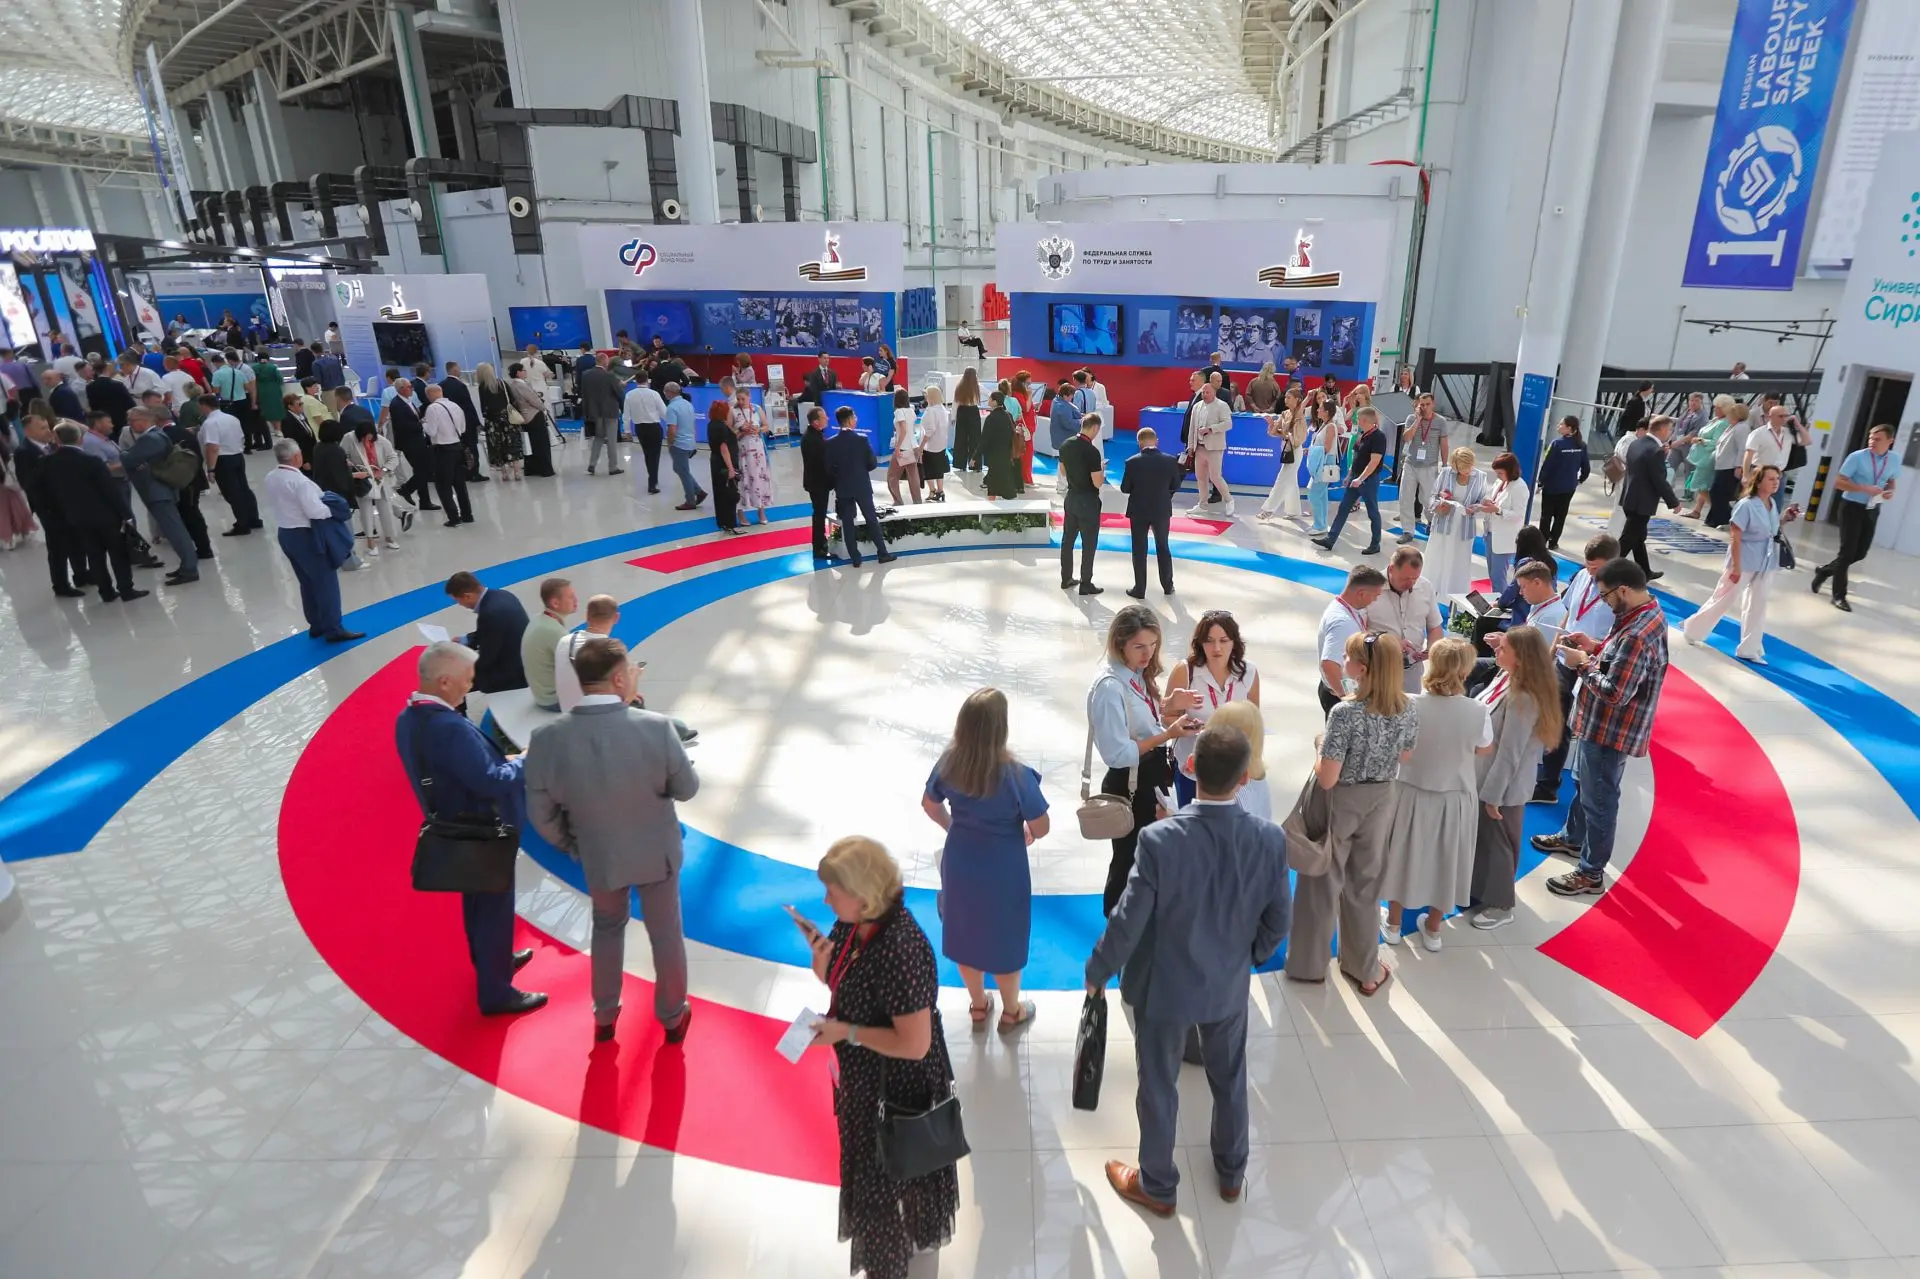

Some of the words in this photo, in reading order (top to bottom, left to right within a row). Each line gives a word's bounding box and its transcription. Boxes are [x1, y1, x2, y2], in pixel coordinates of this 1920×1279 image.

[1738, 53, 1758, 110] RUSSIAN
[1771, 0, 1809, 105] SAFETY
[1791, 16, 1827, 103] WEEK
